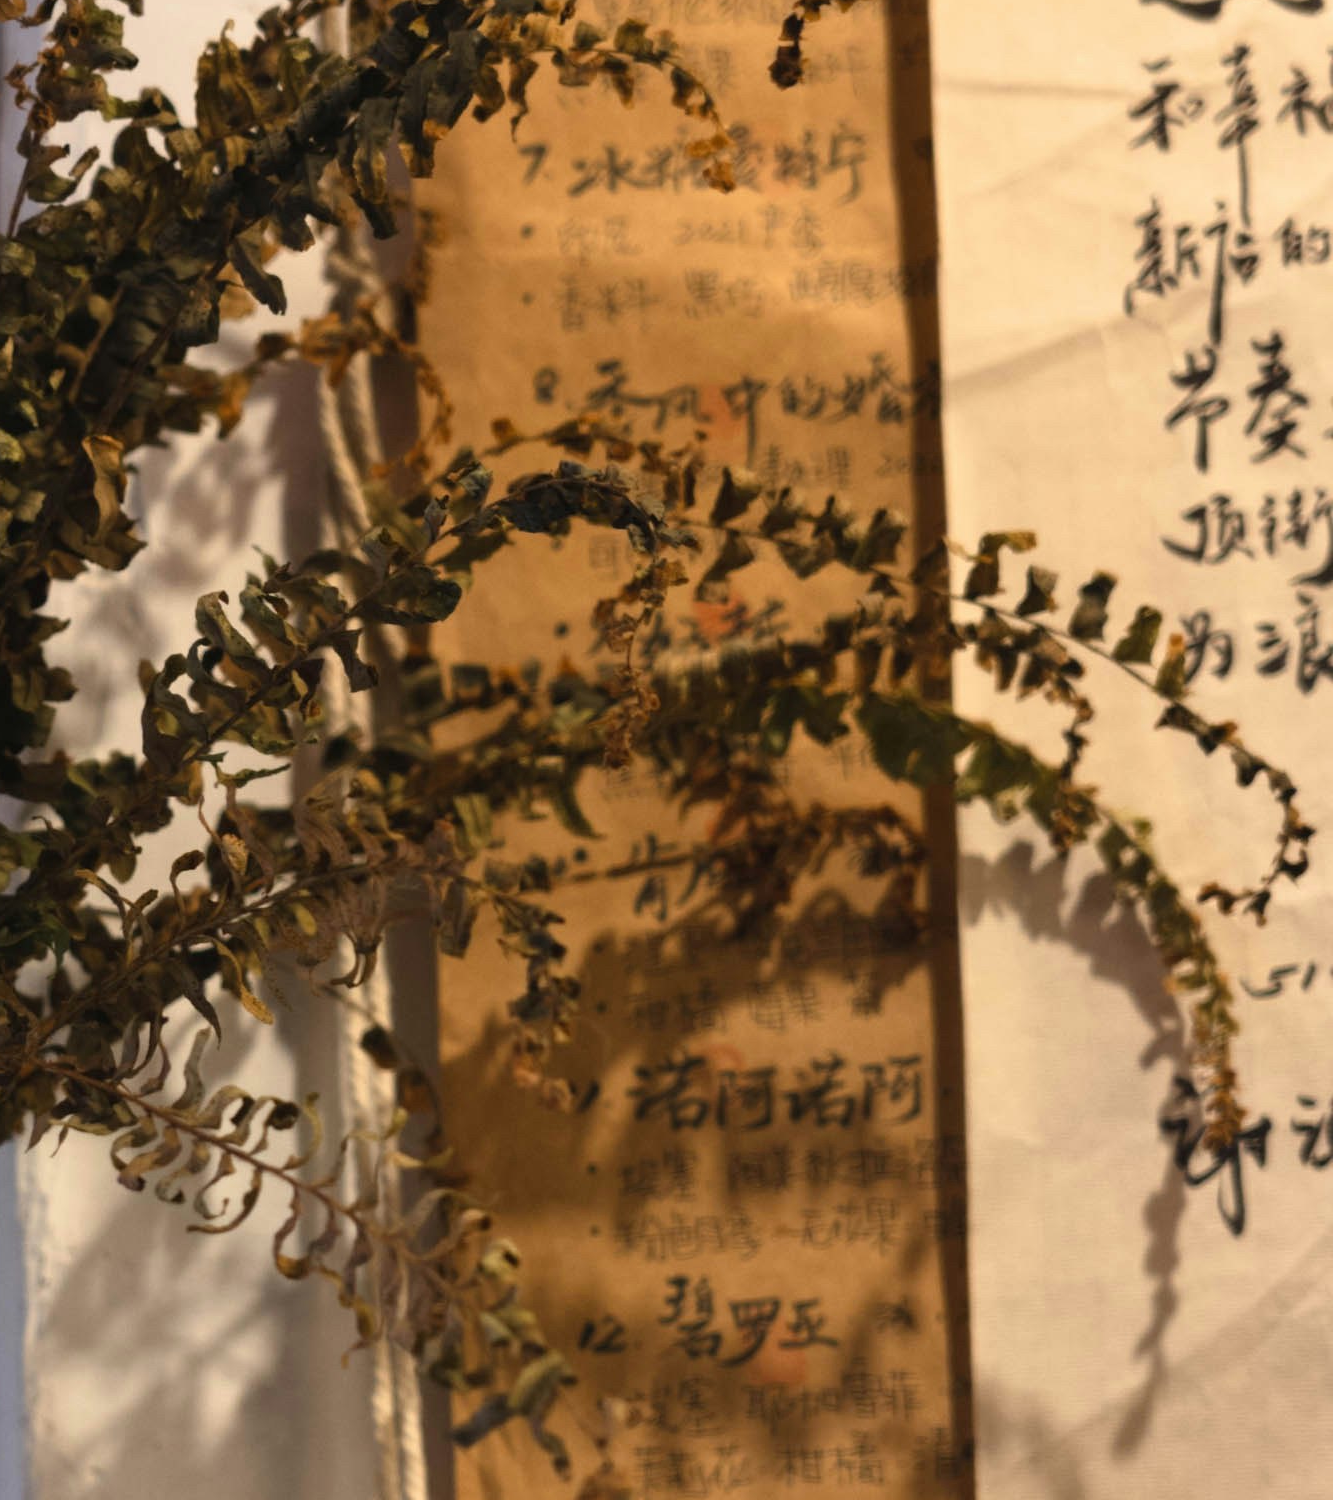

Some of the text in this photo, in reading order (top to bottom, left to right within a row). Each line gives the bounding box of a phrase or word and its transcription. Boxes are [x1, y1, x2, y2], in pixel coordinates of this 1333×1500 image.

[1164, 331, 1333, 476] 节奏
[626, 1047, 924, 1132] 诺阿诺阿
